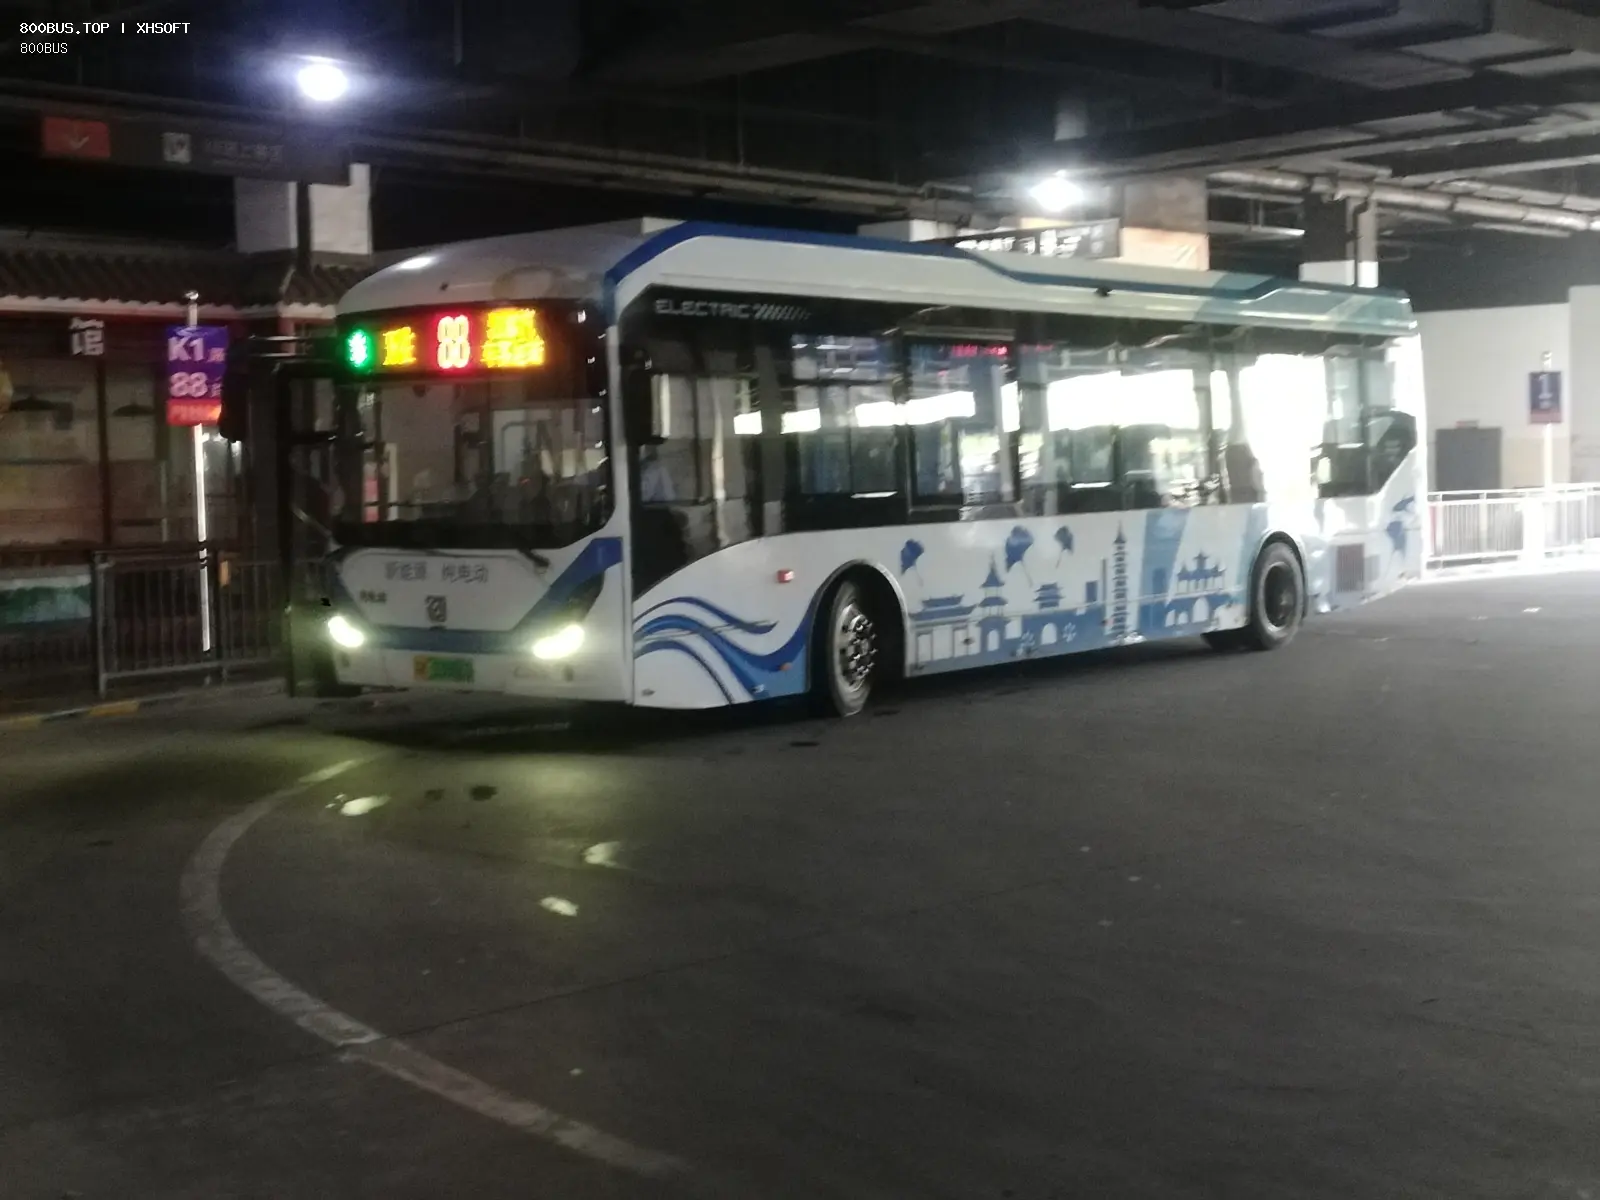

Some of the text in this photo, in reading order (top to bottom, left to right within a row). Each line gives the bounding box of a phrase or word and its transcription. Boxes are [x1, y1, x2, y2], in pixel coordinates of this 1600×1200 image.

[655, 299, 749, 319] ELECTRIC
[168, 336, 204, 361] K1
[437, 314, 471, 369] 88
[169, 371, 208, 398] 88
